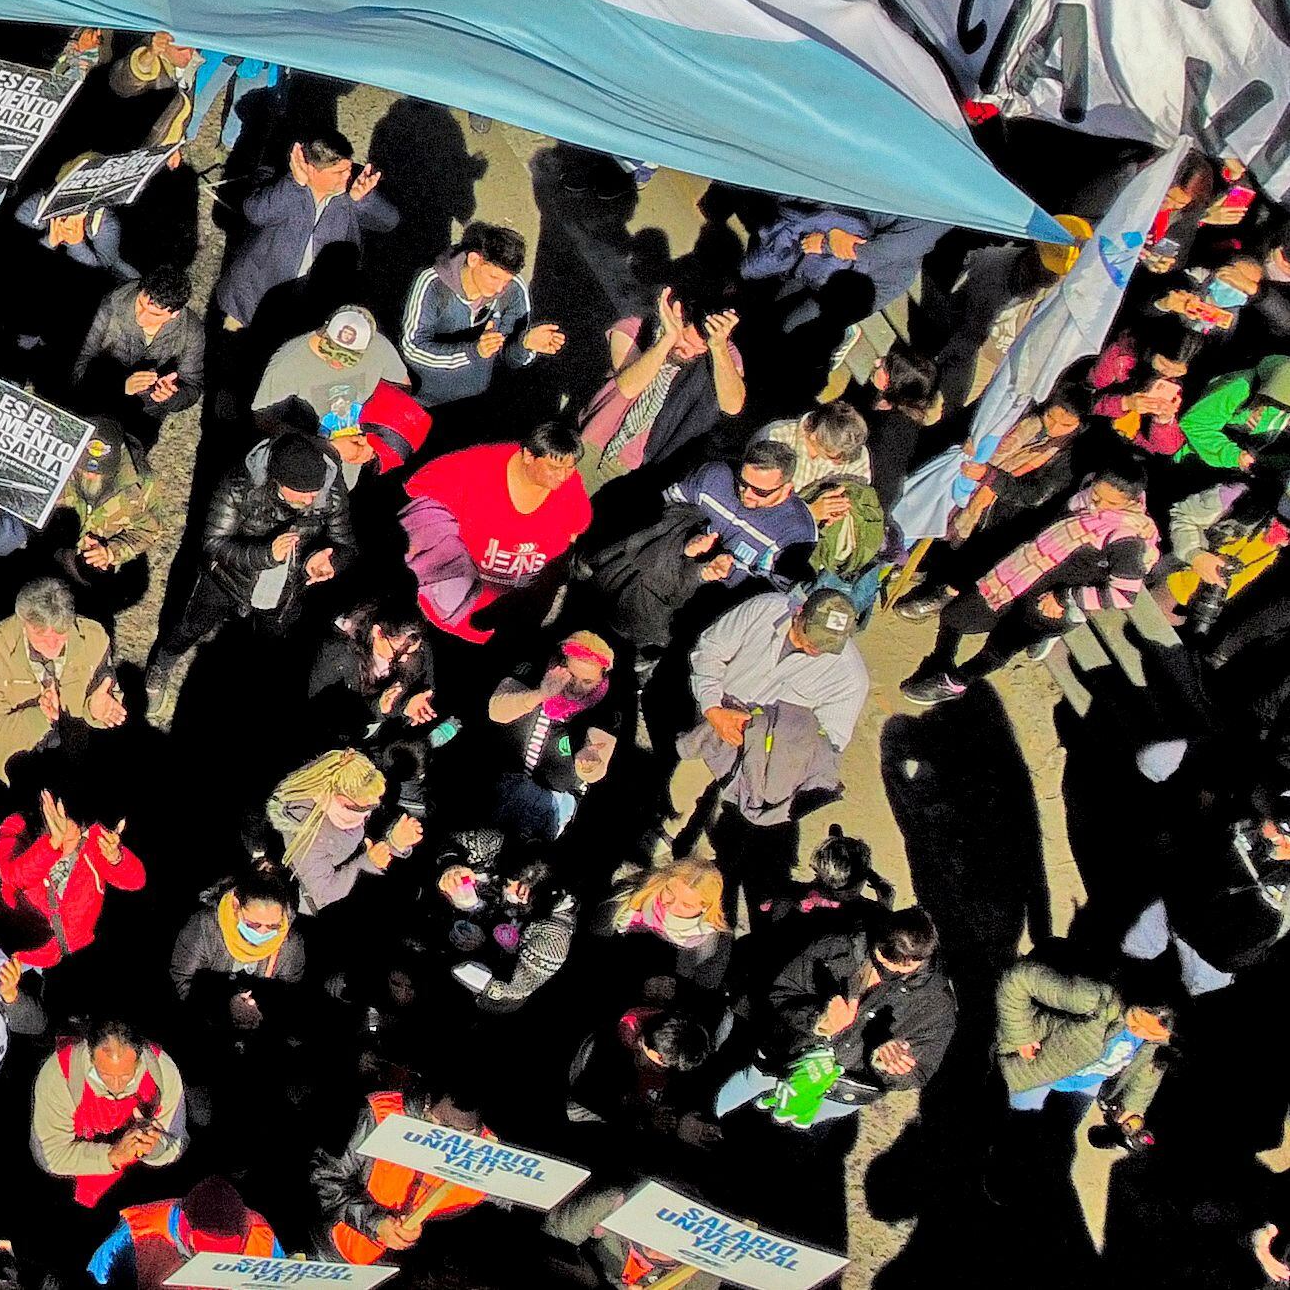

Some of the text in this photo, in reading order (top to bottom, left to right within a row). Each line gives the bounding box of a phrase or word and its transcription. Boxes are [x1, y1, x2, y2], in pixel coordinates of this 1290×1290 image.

[19, 75, 44, 96] EL
[27, 407, 54, 434] EL
[481, 538, 547, 579] JEANS
[403, 1131, 546, 1182] UNIVERSAL
[426, 1128, 541, 1168] SALARIO
[656, 1207, 799, 1272] UNIVERSAL
[683, 1207, 798, 1256] SALARIO
